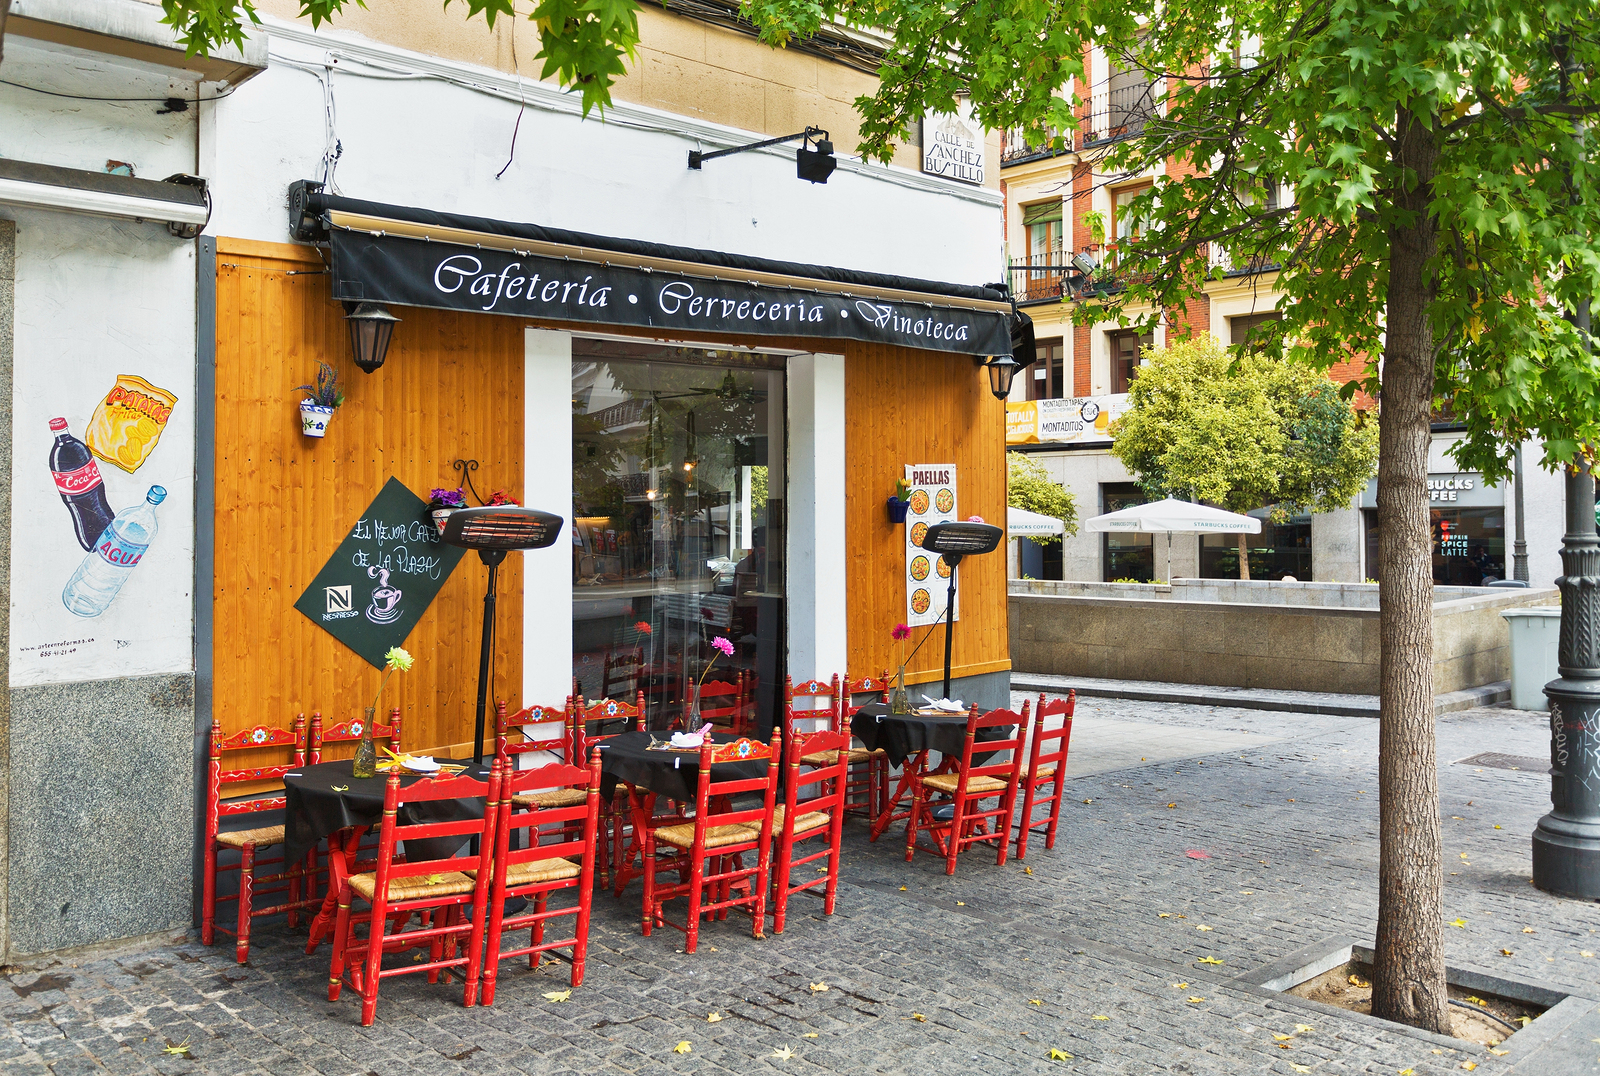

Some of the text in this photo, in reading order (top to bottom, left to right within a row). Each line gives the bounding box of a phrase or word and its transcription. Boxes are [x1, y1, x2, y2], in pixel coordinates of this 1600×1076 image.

[935, 131, 975, 150] CALLE DE
[926, 143, 983, 168] SANCHEZ
[925, 156, 984, 183] BUSTILLO
[434, 254, 968, 341] Cafetería Cervecería Vinoteca
[106, 386, 171, 424] PATATAS
[1069, 398, 1084, 406] TAPAS
[109, 407, 142, 421] Fritas
[1006, 410, 1035, 424] TOTALLY
[1006, 423, 1034, 435] DELICIOUS
[1042, 421, 1084, 433] MONTADITOS
[912, 469, 950, 486] PAELLAS
[1427, 479, 1474, 490] BUCKS
[100, 541, 143, 565] AGUA
[1441, 548, 1468, 557] LATTE
[322, 610, 360, 622] NESPRESSO
